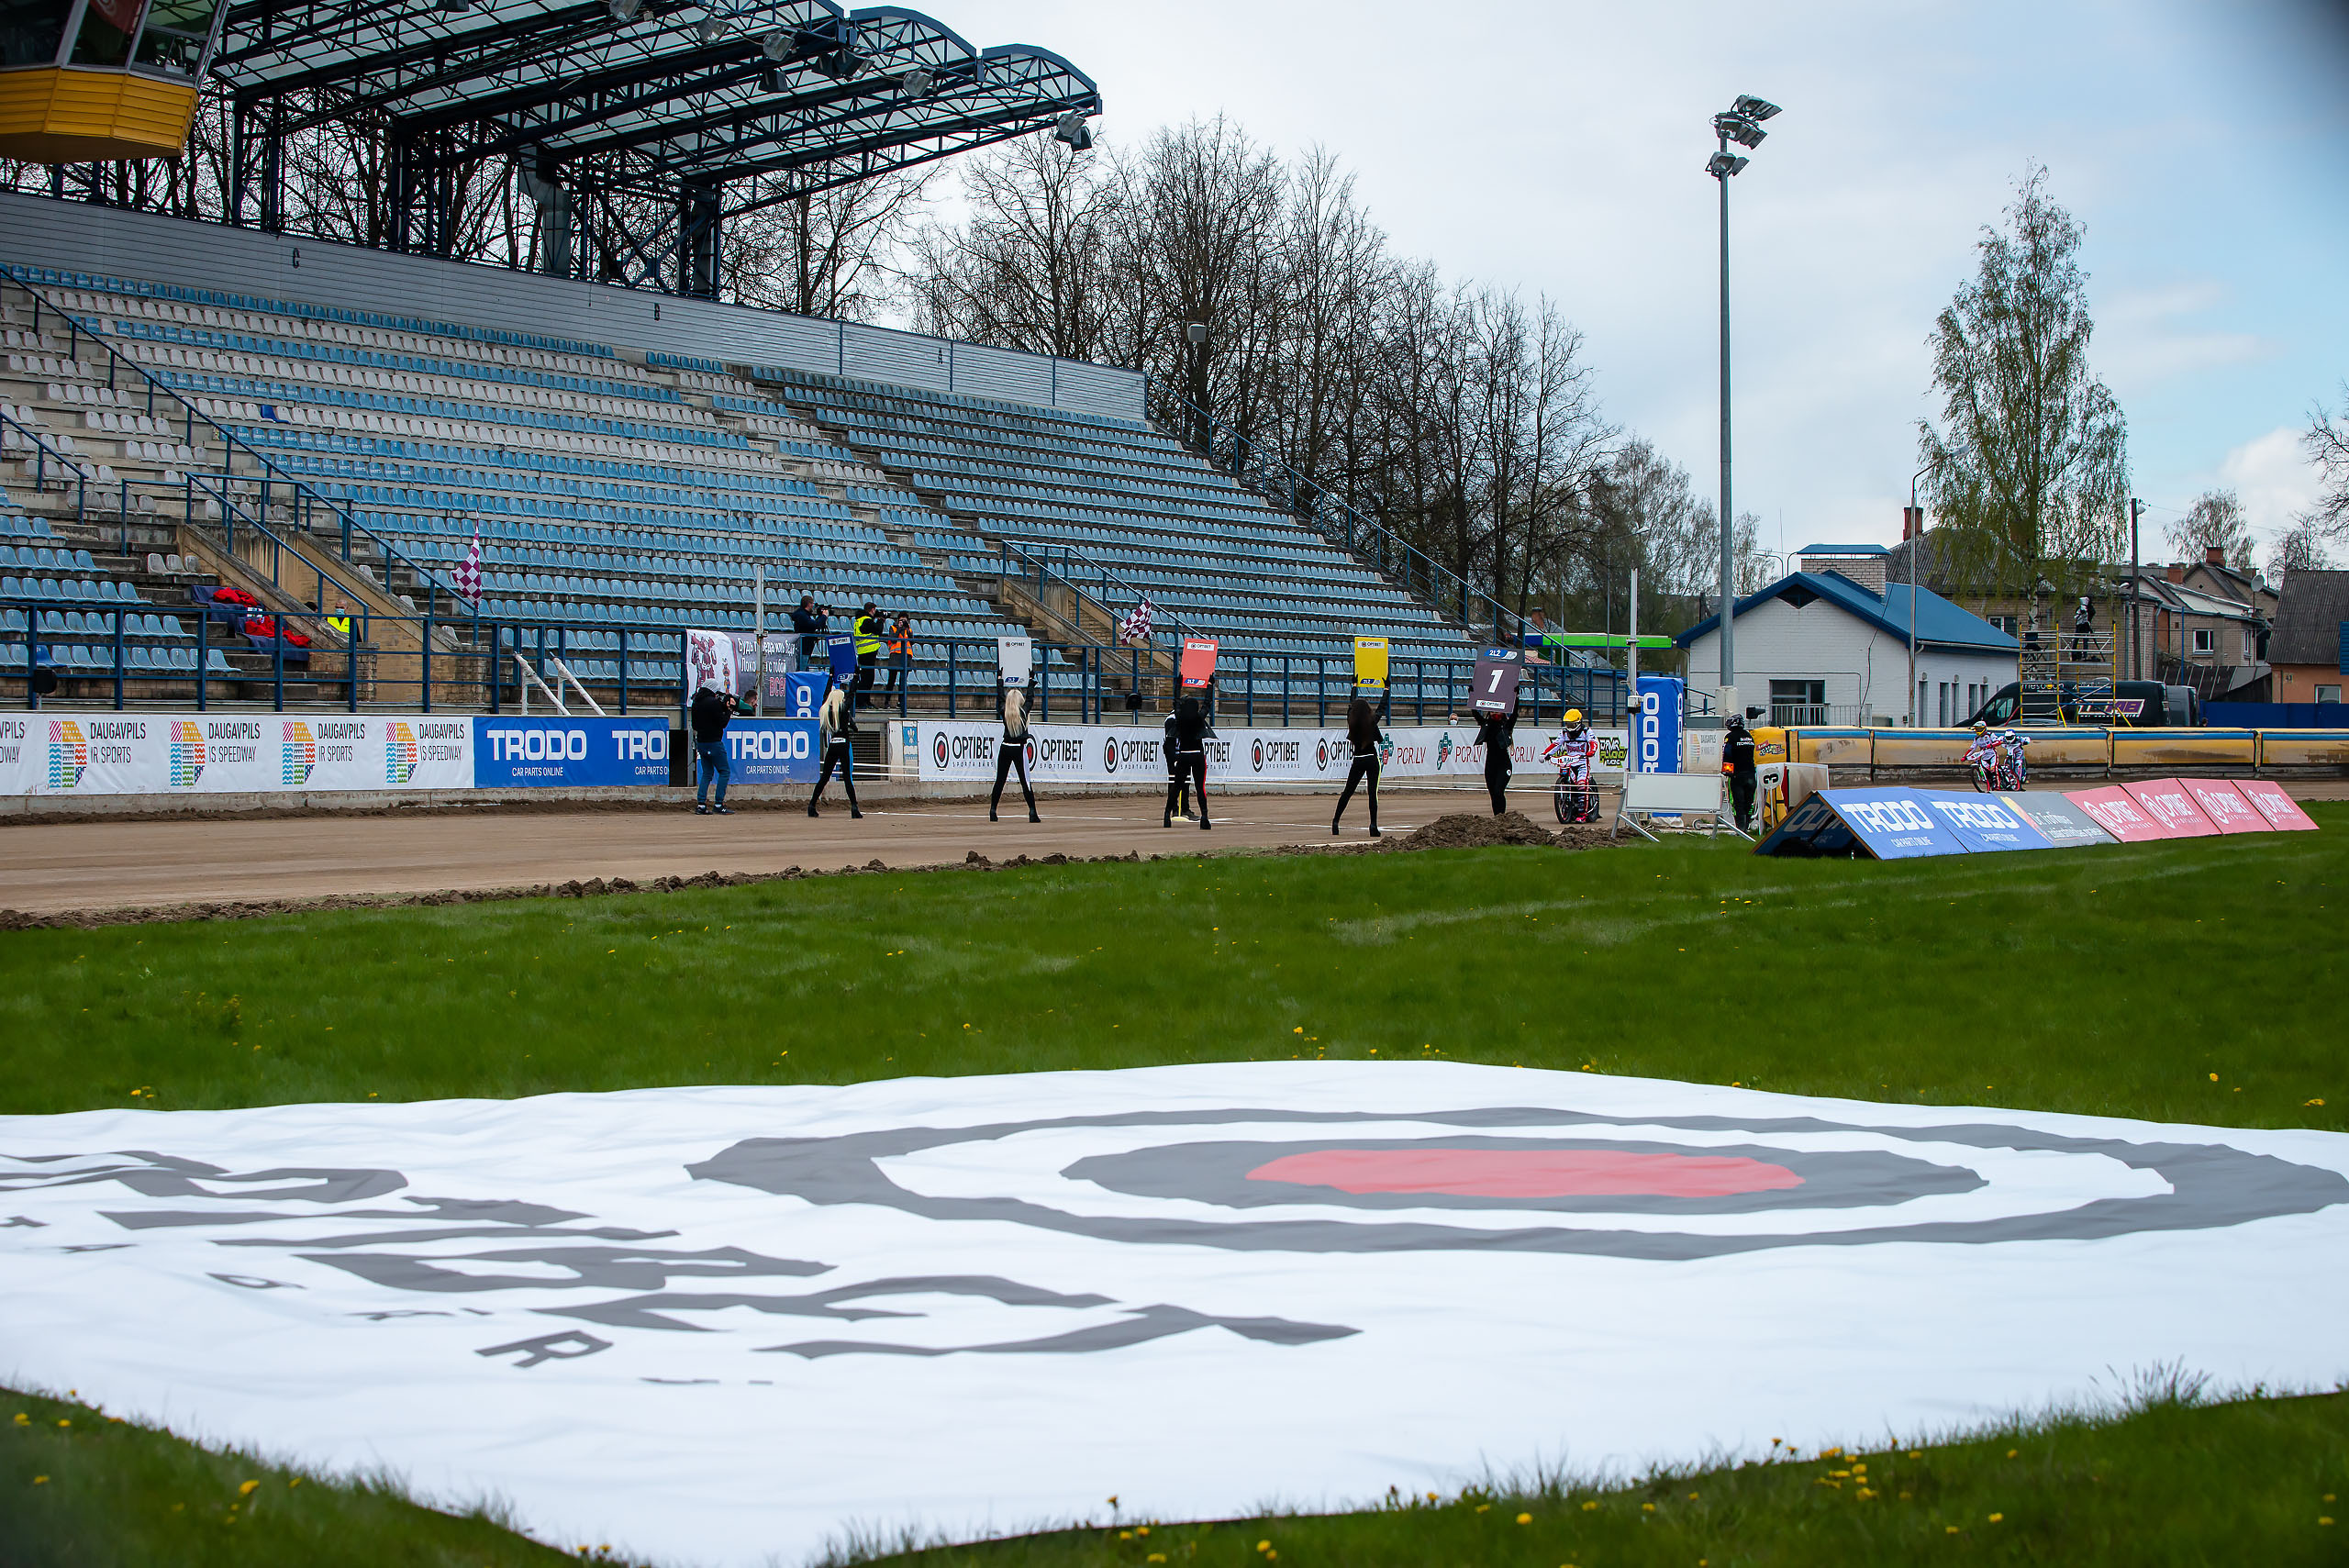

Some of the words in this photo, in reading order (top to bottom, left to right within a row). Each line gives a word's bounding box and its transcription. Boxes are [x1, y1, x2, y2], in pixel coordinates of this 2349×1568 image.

[1487, 669, 1504, 694] 1
[90, 722, 146, 740] DAUGAVPILS
[208, 722, 261, 740] DAUGAVPILS
[317, 723, 365, 740] DAUGAVPILS
[418, 723, 465, 740] DAUGAVPILS
[208, 746, 217, 762] IS
[218, 745, 257, 762] SPEEDWAY
[318, 745, 326, 762] IR
[327, 745, 353, 762] SPORTS
[419, 745, 427, 761] IS
[428, 745, 462, 761] SPEEDWAY
[486, 729, 587, 761] TRODO
[611, 730, 670, 760] TRO
[727, 731, 810, 760] TRODO
[952, 735, 995, 760] OPTIBET
[1041, 738, 1083, 762] OPTIBET
[1121, 740, 1160, 762] OPTIBET
[1266, 741, 1299, 762] OPTIBET
[1455, 746, 1483, 762] PCR.LV
[91, 746, 98, 763] IR
[101, 746, 132, 763] SPORTS
[1397, 747, 1427, 764] PCR.LV
[512, 767, 524, 776] CAR
[524, 767, 542, 776] PARTS
[542, 767, 563, 776] ONLINE
[635, 766, 646, 775] CAR
[647, 766, 663, 775] PARTS
[746, 765, 757, 774] CAR
[757, 765, 773, 774] PARTS
[773, 765, 790, 774] ONLINE
[2154, 794, 2196, 817] OPTIBET
[1839, 800, 1934, 833] TRODO
[1931, 802, 2020, 828] TRODO
